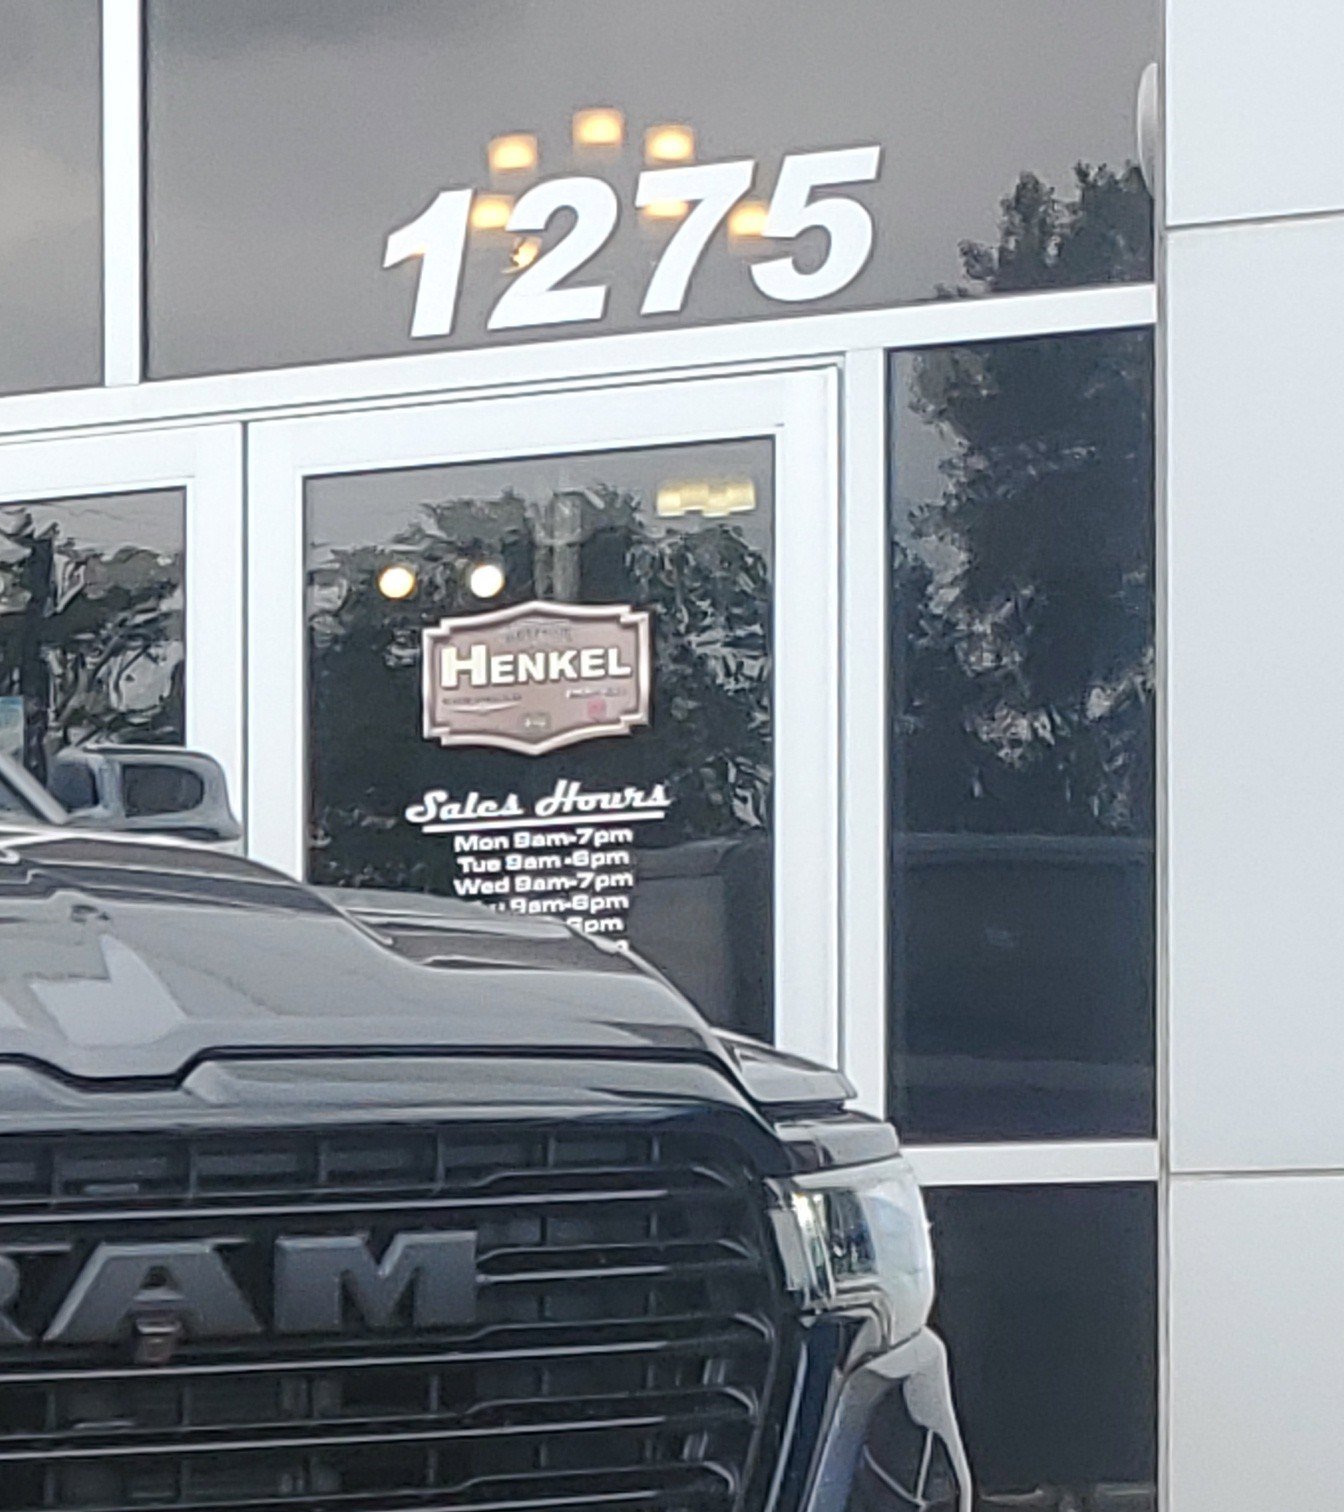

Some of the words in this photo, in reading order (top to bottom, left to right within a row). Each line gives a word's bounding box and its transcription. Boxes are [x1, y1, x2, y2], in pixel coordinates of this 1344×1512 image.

[381, 144, 883, 339] 1275
[440, 644, 633, 688] HENKEL
[405, 789, 524, 823] Sales
[535, 778, 673, 817] Hours
[454, 834, 509, 852] Mon
[457, 855, 501, 874] Tue
[452, 876, 509, 896] Wed
